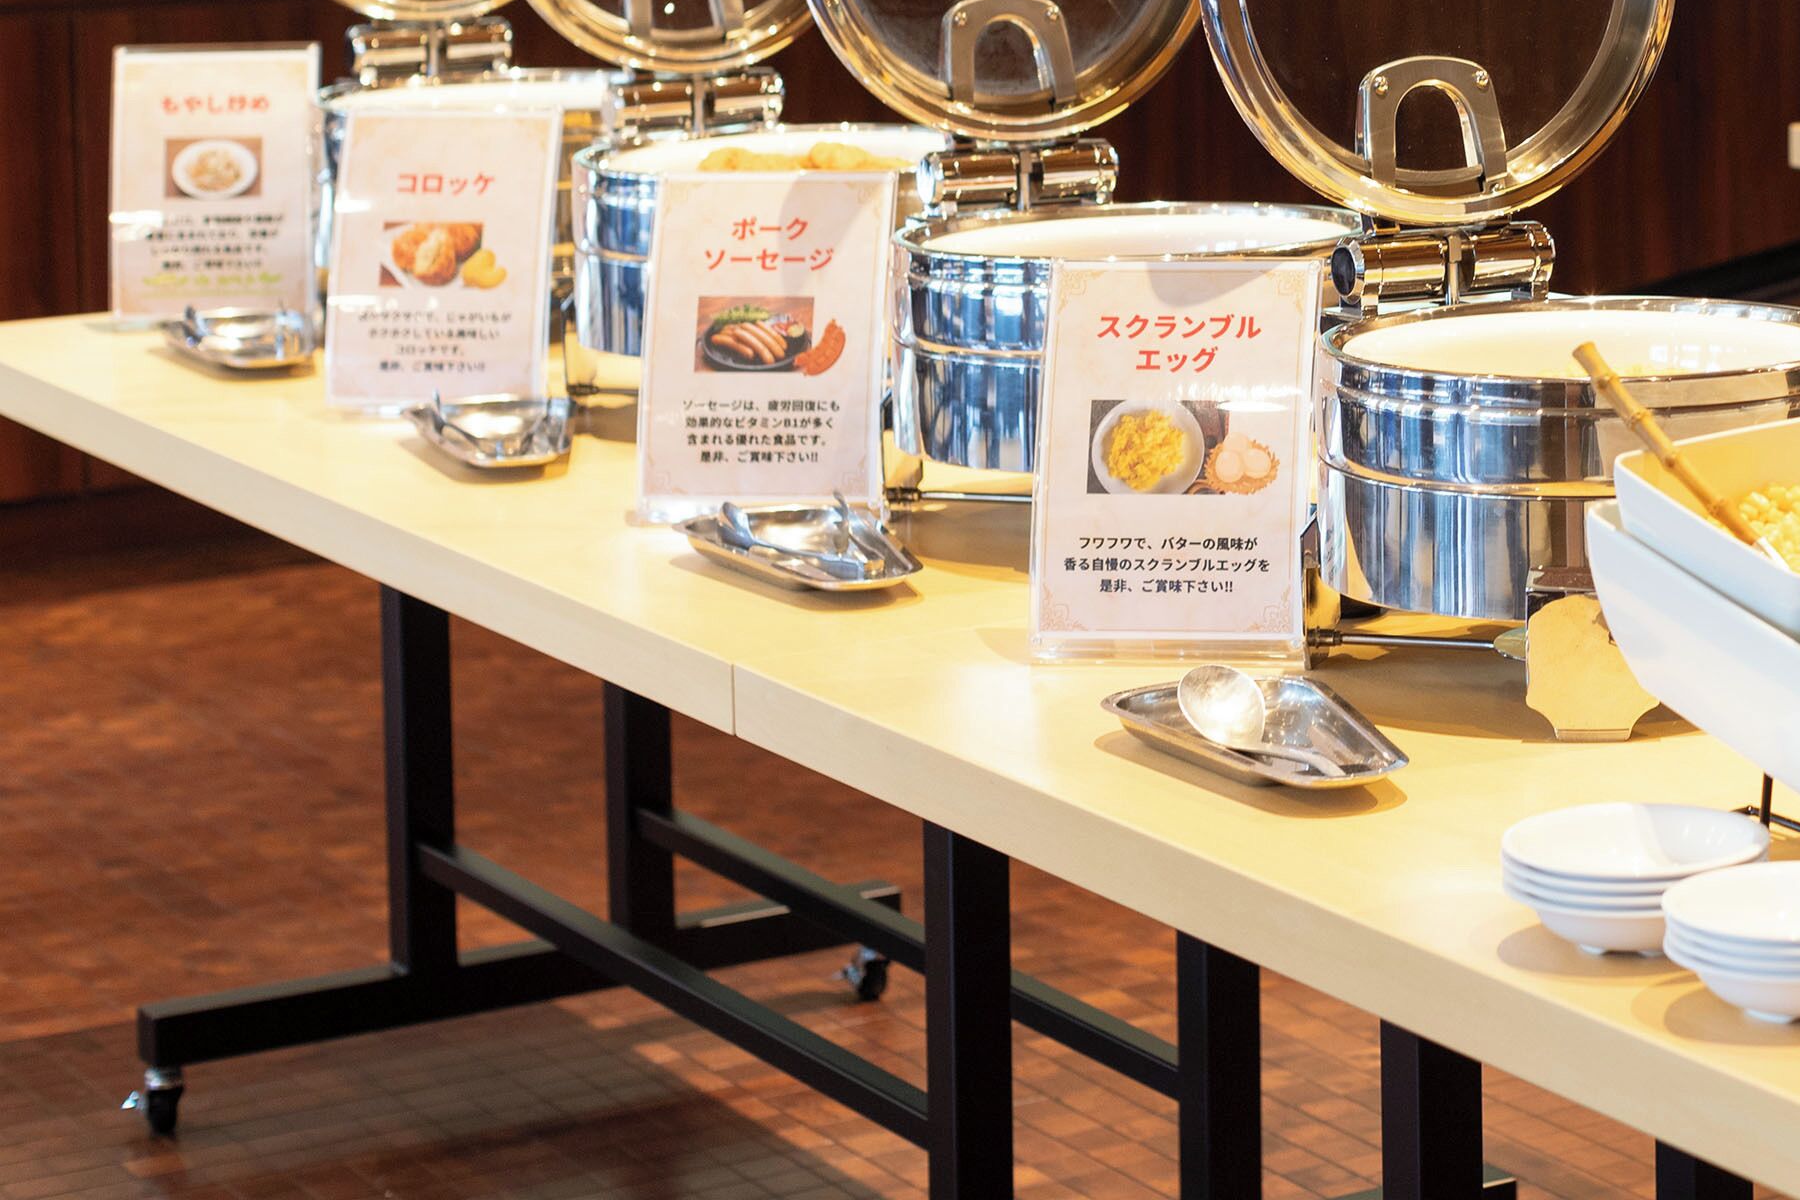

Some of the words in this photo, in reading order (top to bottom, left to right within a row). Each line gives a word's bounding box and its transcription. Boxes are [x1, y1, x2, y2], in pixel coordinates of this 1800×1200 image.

[396, 172, 496, 196] コロッケ
[731, 216, 809, 241] ポーク
[704, 247, 835, 272] ソーセージ
[1096, 313, 1262, 340] スクランブル
[1135, 346, 1219, 373] エッグ
[1079, 536, 1258, 551] フワフワで、バターの風味が
[1063, 556, 1270, 573] 香る自慢のスクランブルエッグを
